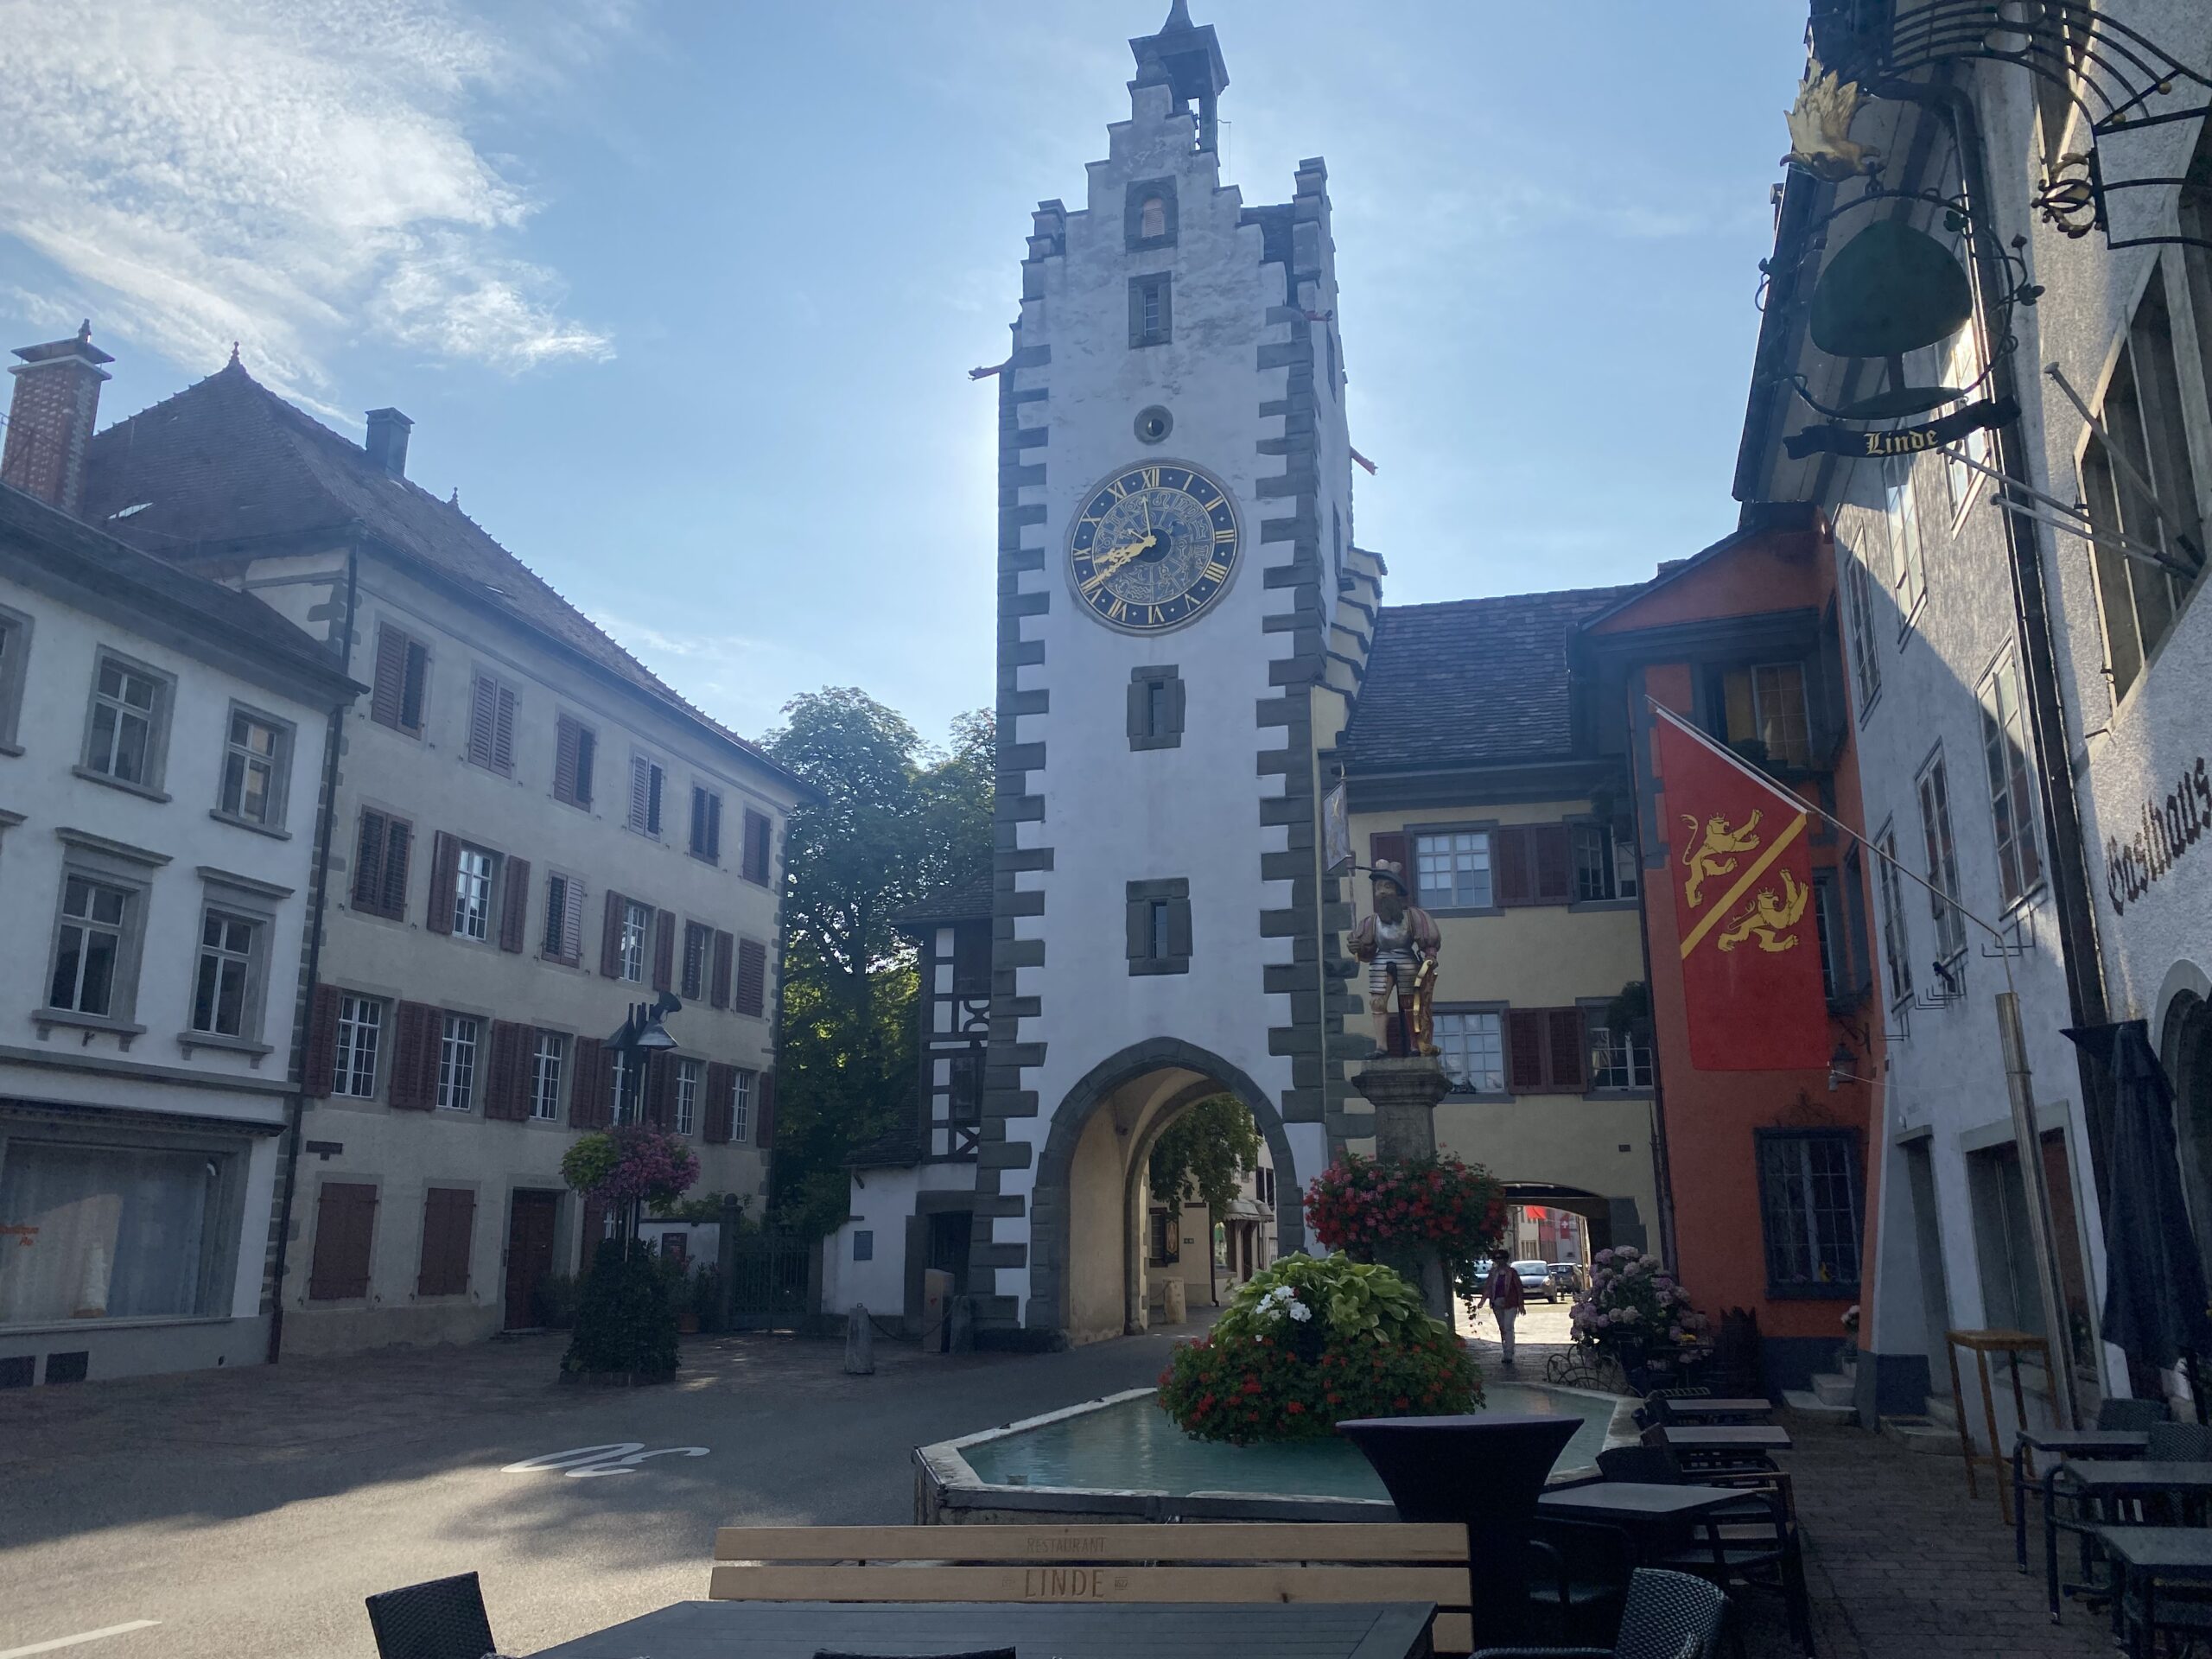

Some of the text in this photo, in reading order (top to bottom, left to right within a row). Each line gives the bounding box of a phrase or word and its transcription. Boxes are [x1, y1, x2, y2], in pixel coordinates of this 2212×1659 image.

[1864, 429, 1939, 456] Linde
[1027, 1536, 1107, 1554] RESTAURANT
[1024, 1568, 1106, 1599] LINDE
